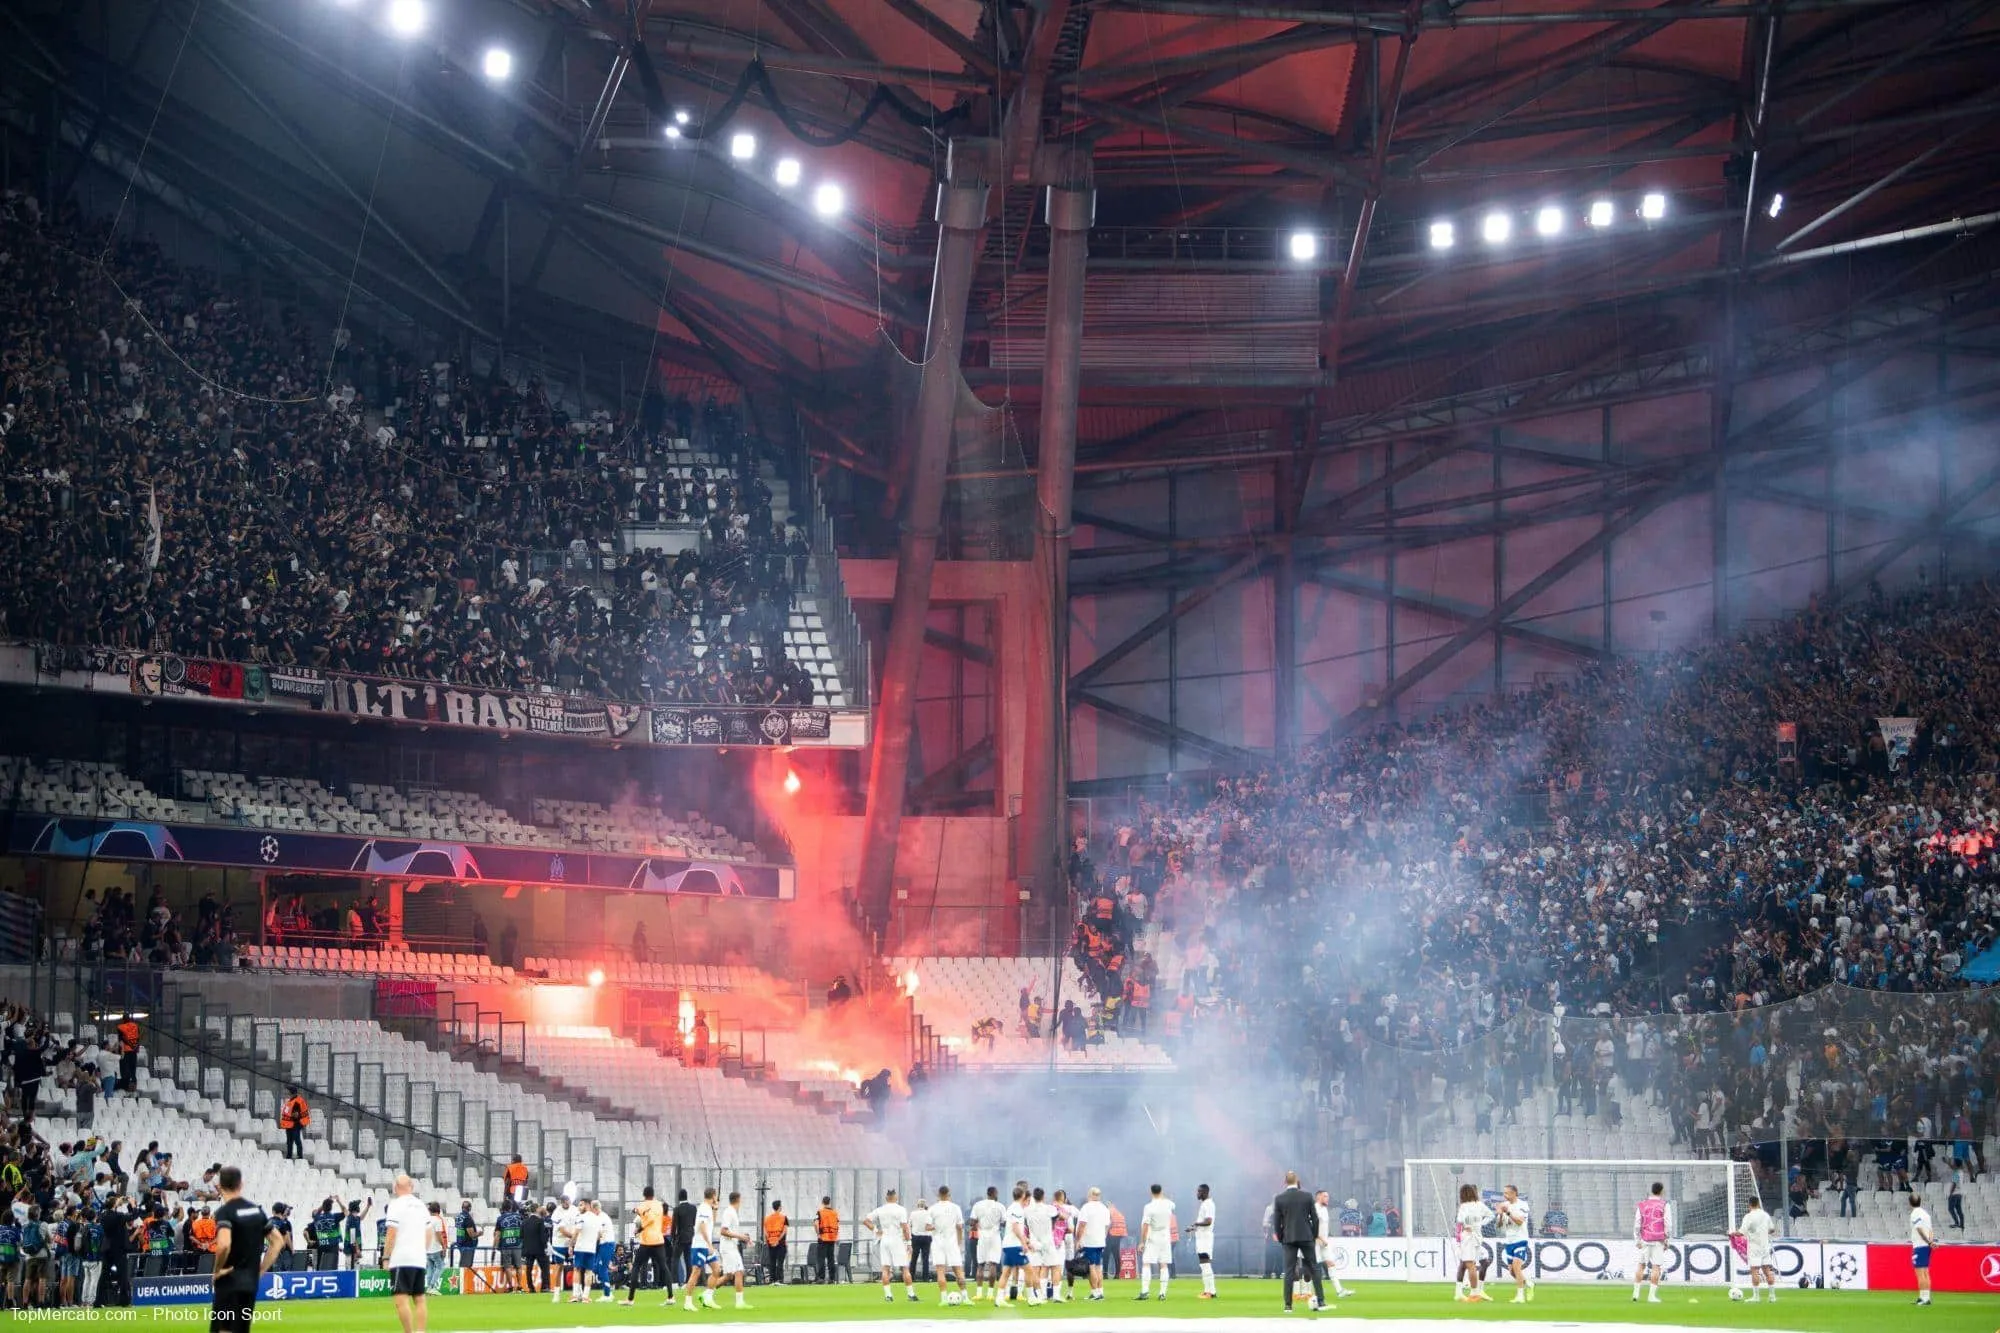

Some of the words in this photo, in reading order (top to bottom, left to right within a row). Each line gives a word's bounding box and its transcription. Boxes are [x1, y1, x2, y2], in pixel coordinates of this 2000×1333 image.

[278, 666, 318, 679] NEVER
[137, 1286, 160, 1298] UEFA
[161, 1283, 209, 1297] CHAMPIONS
[291, 1276, 338, 1294] PS5
[359, 1276, 386, 1292] enjoy
